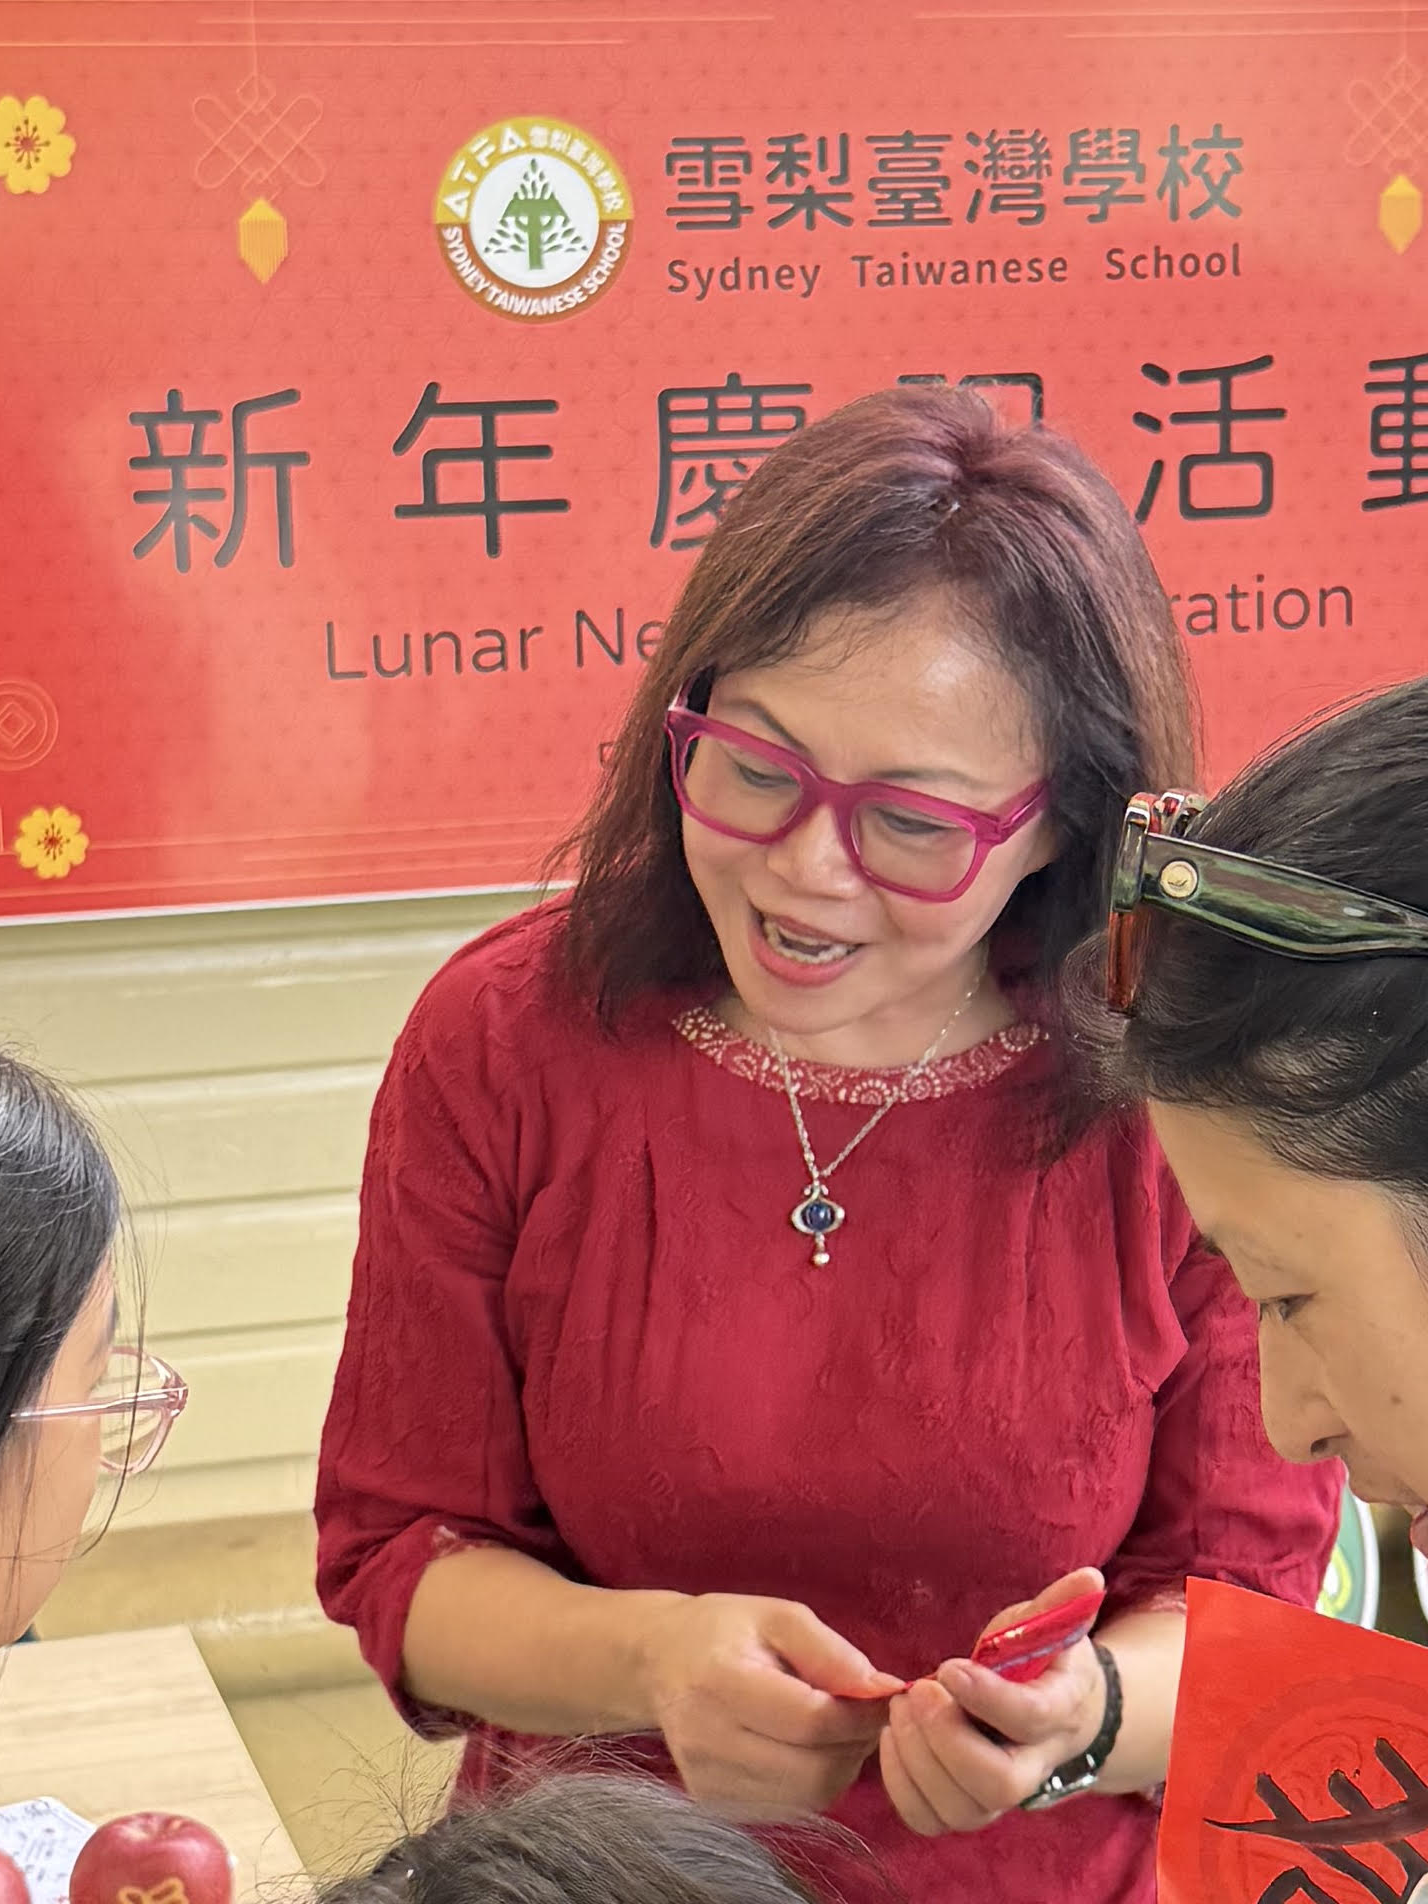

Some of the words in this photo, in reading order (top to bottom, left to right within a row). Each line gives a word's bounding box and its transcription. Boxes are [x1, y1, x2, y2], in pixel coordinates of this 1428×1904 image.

[664, 124, 1246, 231] 雪梨臺灣學校
[441, 225, 491, 294] SYDNEY
[486, 283, 588, 317] TAIWANESE
[583, 221, 627, 295] SCHOOL
[667, 256, 820, 299] Sydney
[852, 252, 1069, 287] Taiwanese
[1105, 243, 1243, 281] School
[326, 620, 544, 681] Lunar
[575, 607, 665, 670] Ne
